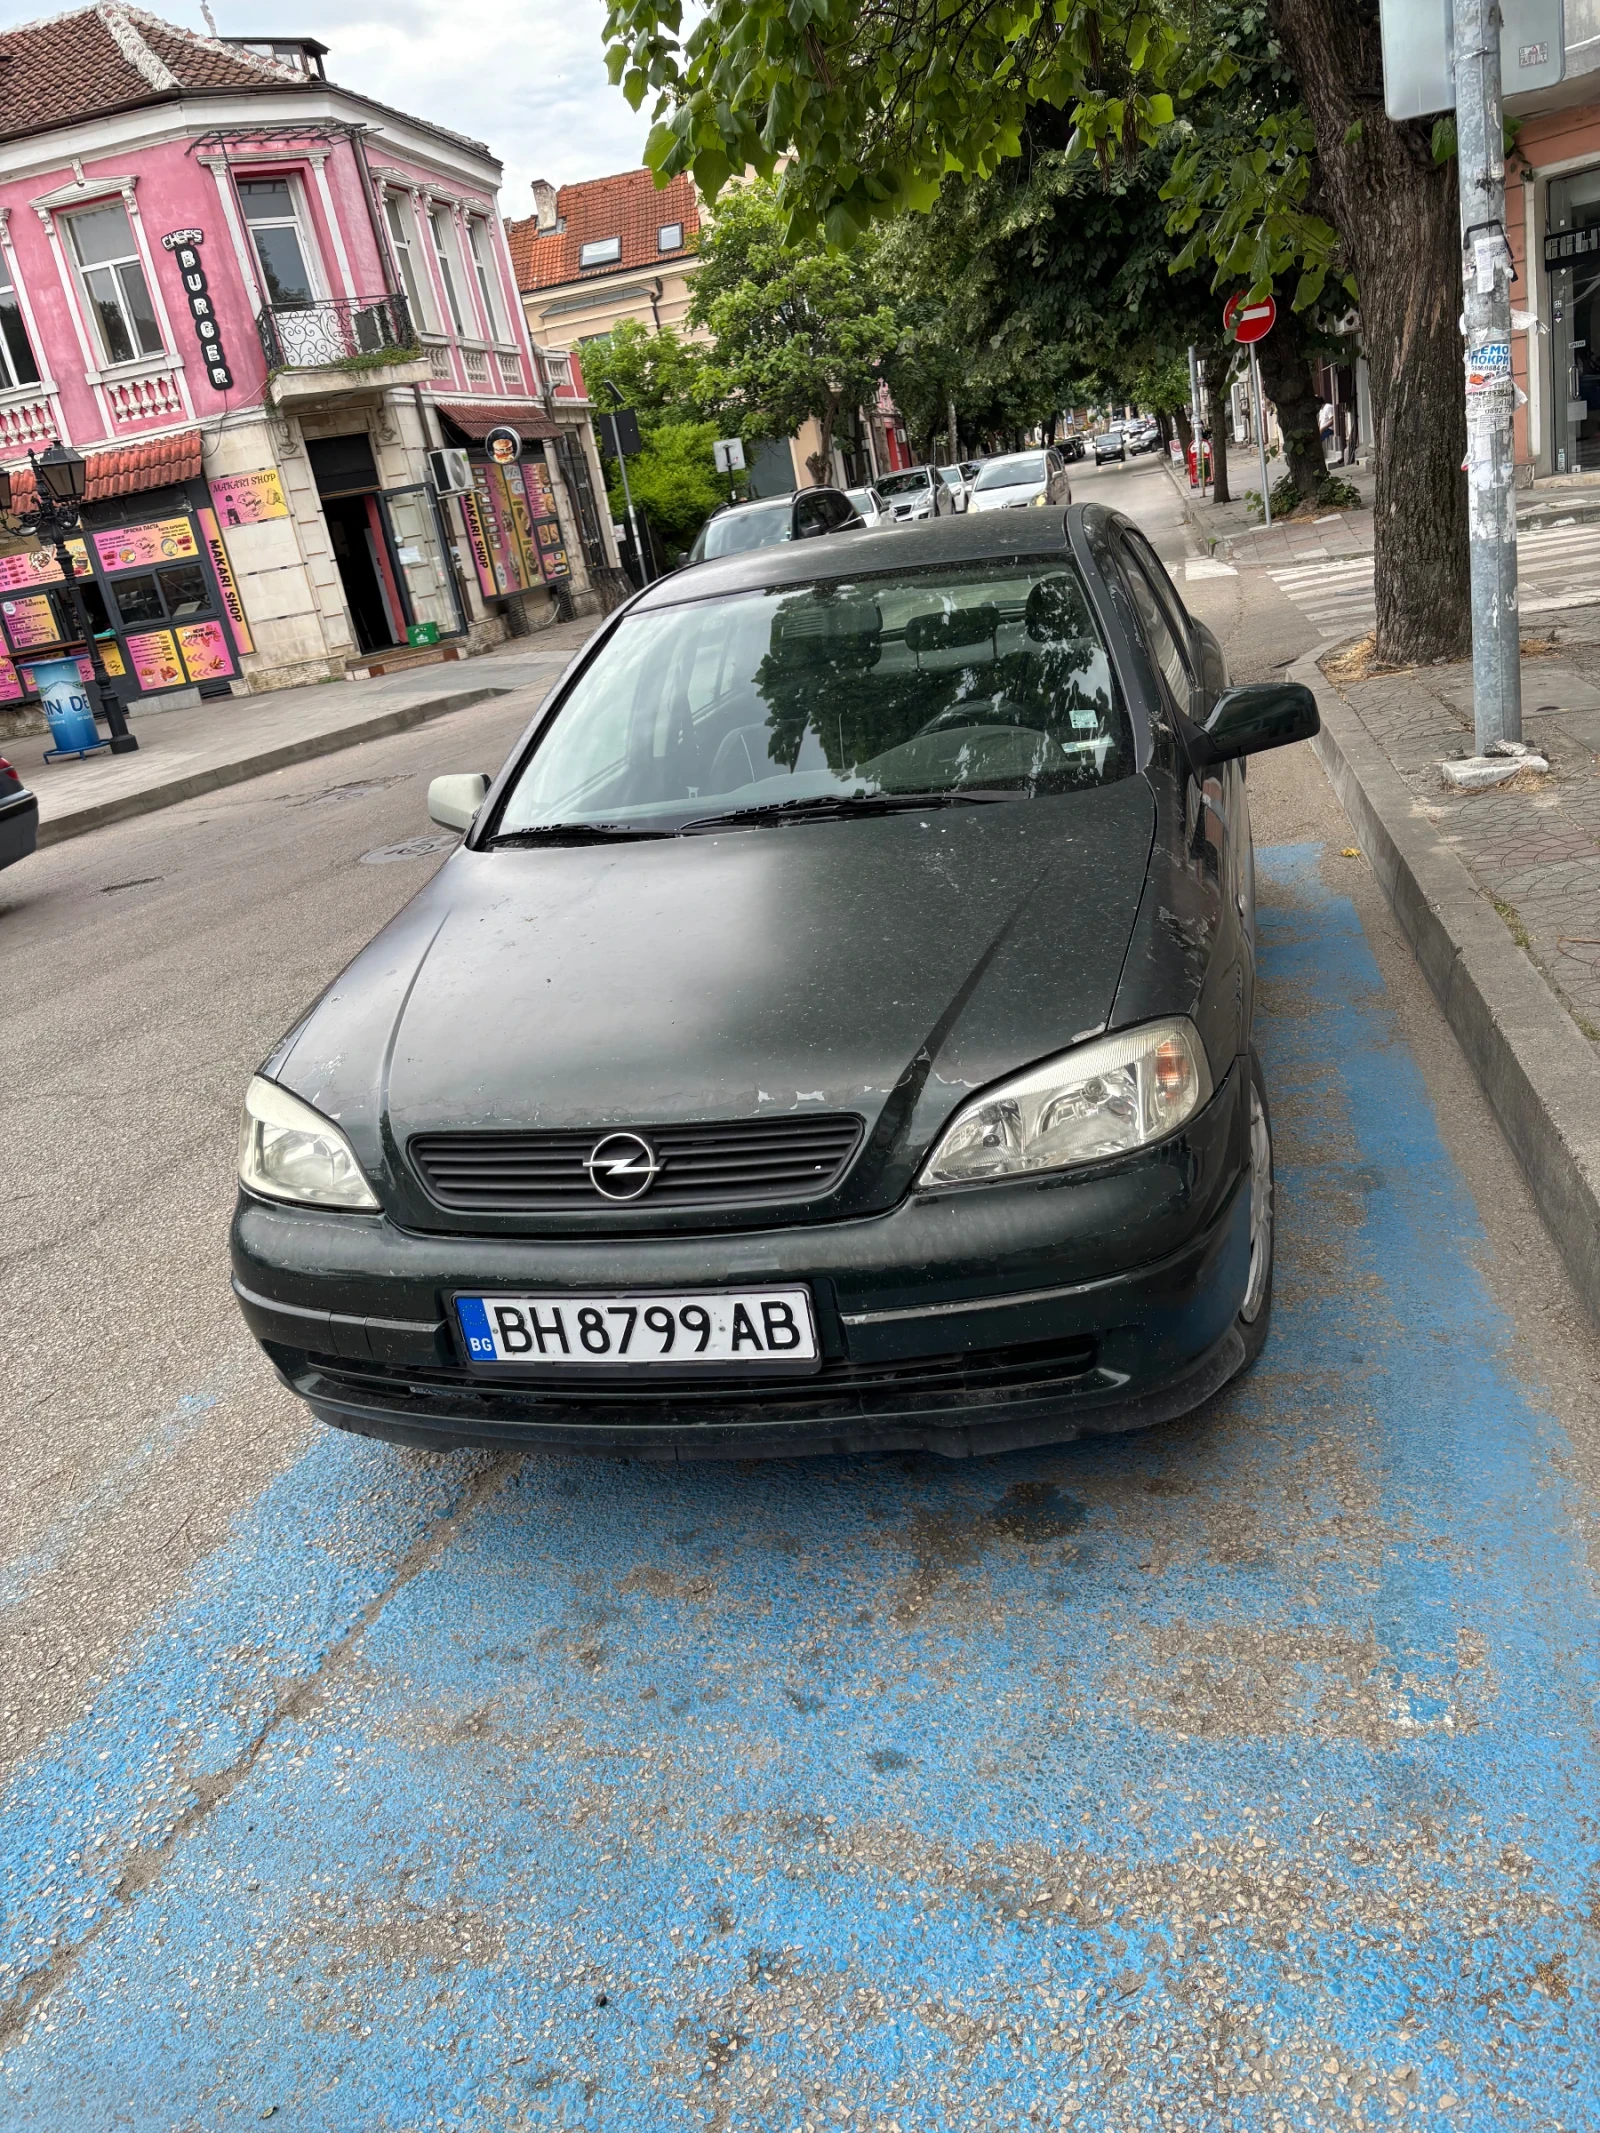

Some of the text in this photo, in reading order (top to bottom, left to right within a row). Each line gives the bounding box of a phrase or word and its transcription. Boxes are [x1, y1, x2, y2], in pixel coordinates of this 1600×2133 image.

[180, 250, 228, 384] BURGER
[213, 473, 276, 493] MAKARI SHOP
[464, 493, 488, 569] MAKARI SHOP
[209, 539, 242, 622] MAKARI SHOP
[471, 1300, 801, 1354] BG BH 8799 AB
